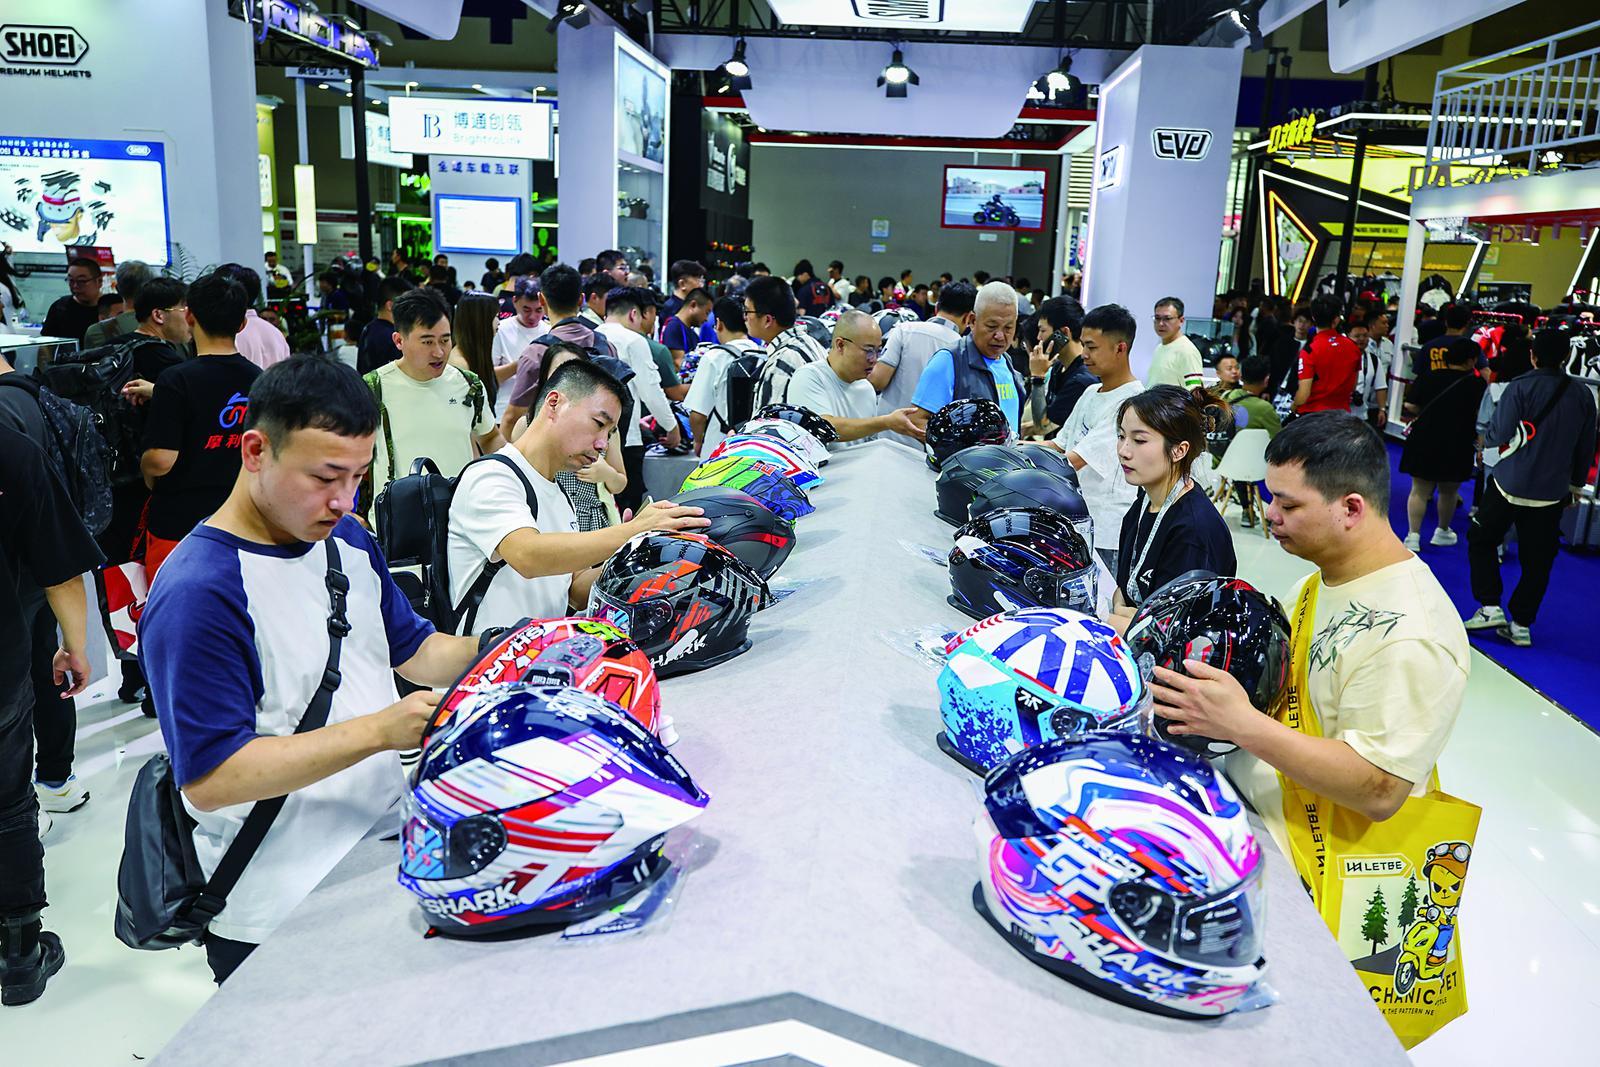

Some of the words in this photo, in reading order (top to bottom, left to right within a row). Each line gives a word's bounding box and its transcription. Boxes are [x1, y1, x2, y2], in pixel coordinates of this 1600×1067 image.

[5, 32, 75, 58] SHOEI
[0, 67, 41, 77] REMIUM
[44, 69, 91, 78] HELMETS
[648, 632, 708, 669] HARK
[1287, 685, 1300, 729] LETBE
[1304, 803, 1327, 856] LETBE
[1364, 861, 1403, 871] LETBE
[423, 880, 517, 914] SHARK
[1064, 914, 1201, 990] SHARK
